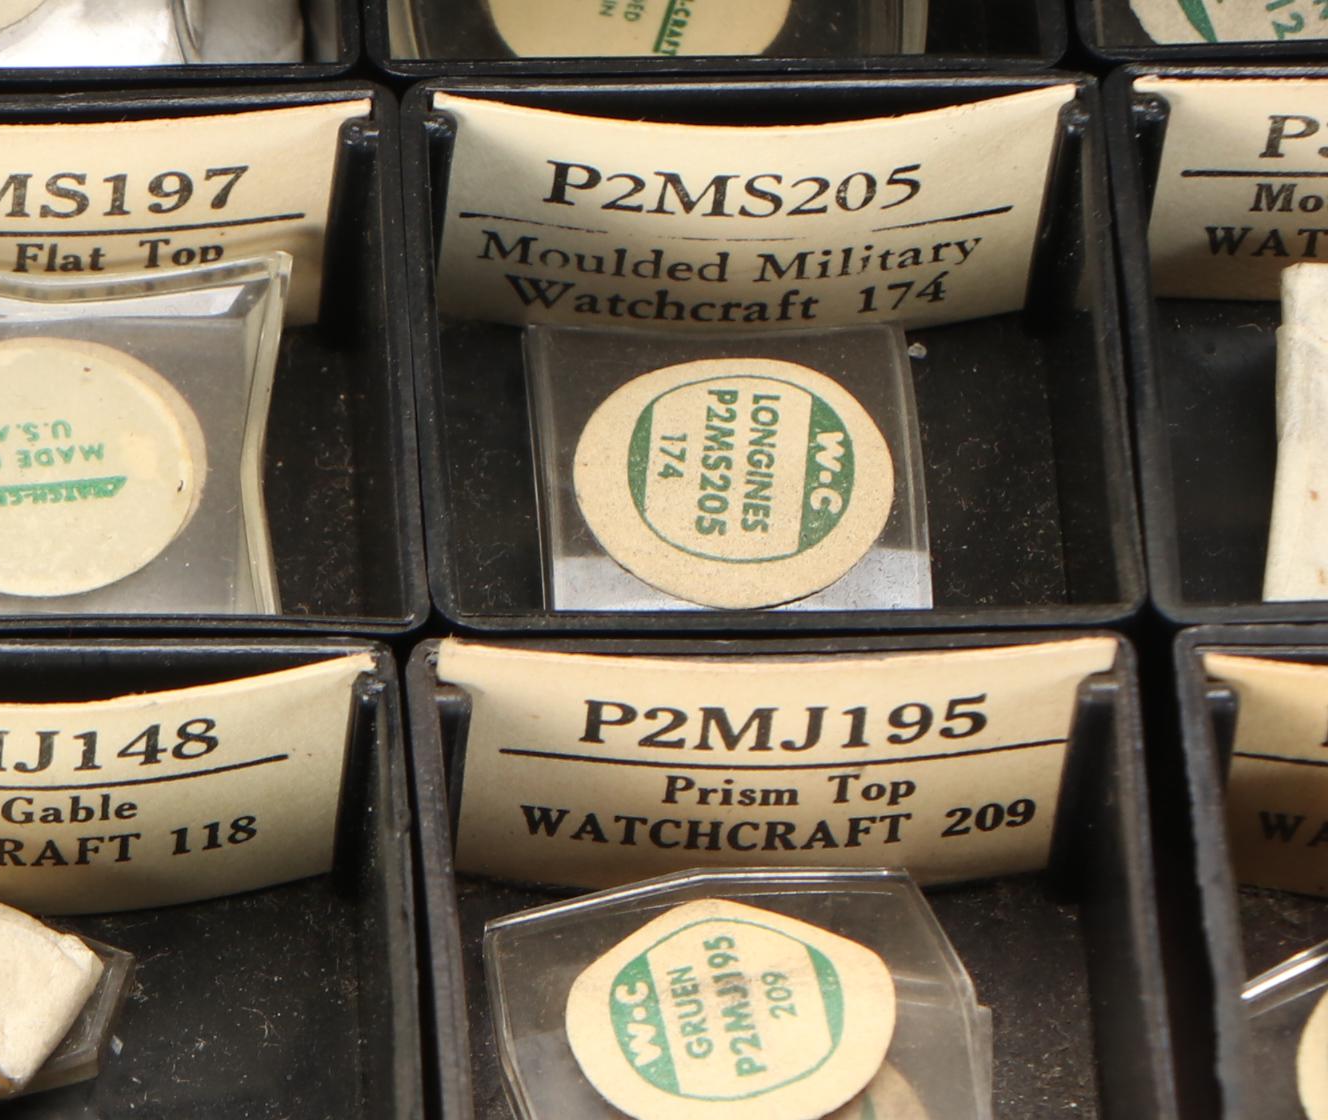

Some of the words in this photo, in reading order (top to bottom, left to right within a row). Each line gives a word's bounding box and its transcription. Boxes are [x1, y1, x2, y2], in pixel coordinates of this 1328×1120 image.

[542, 159, 923, 219] P2MS205
[13, 244, 105, 274] Flat
[140, 240, 224, 268] Top
[478, 229, 730, 284] Moulded
[754, 236, 983, 284] Military
[505, 272, 820, 323] Watchcraft
[858, 273, 948, 316] 174
[16, 443, 105, 468] MADE
[658, 432, 688, 480] 174
[695, 389, 738, 536] P2MS205
[740, 393, 781, 534] LONGINES
[579, 693, 987, 752] P2MJ195
[2, 794, 138, 824] Gable
[661, 775, 799, 807] Prism
[827, 773, 916, 805] Top
[171, 815, 258, 856] 118
[520, 805, 911, 851] WATCHCRAFT
[941, 798, 1035, 838] 209
[666, 965, 714, 1059] GRUEN
[703, 935, 767, 1077] P2MJ195
[761, 971, 798, 1020] 209
